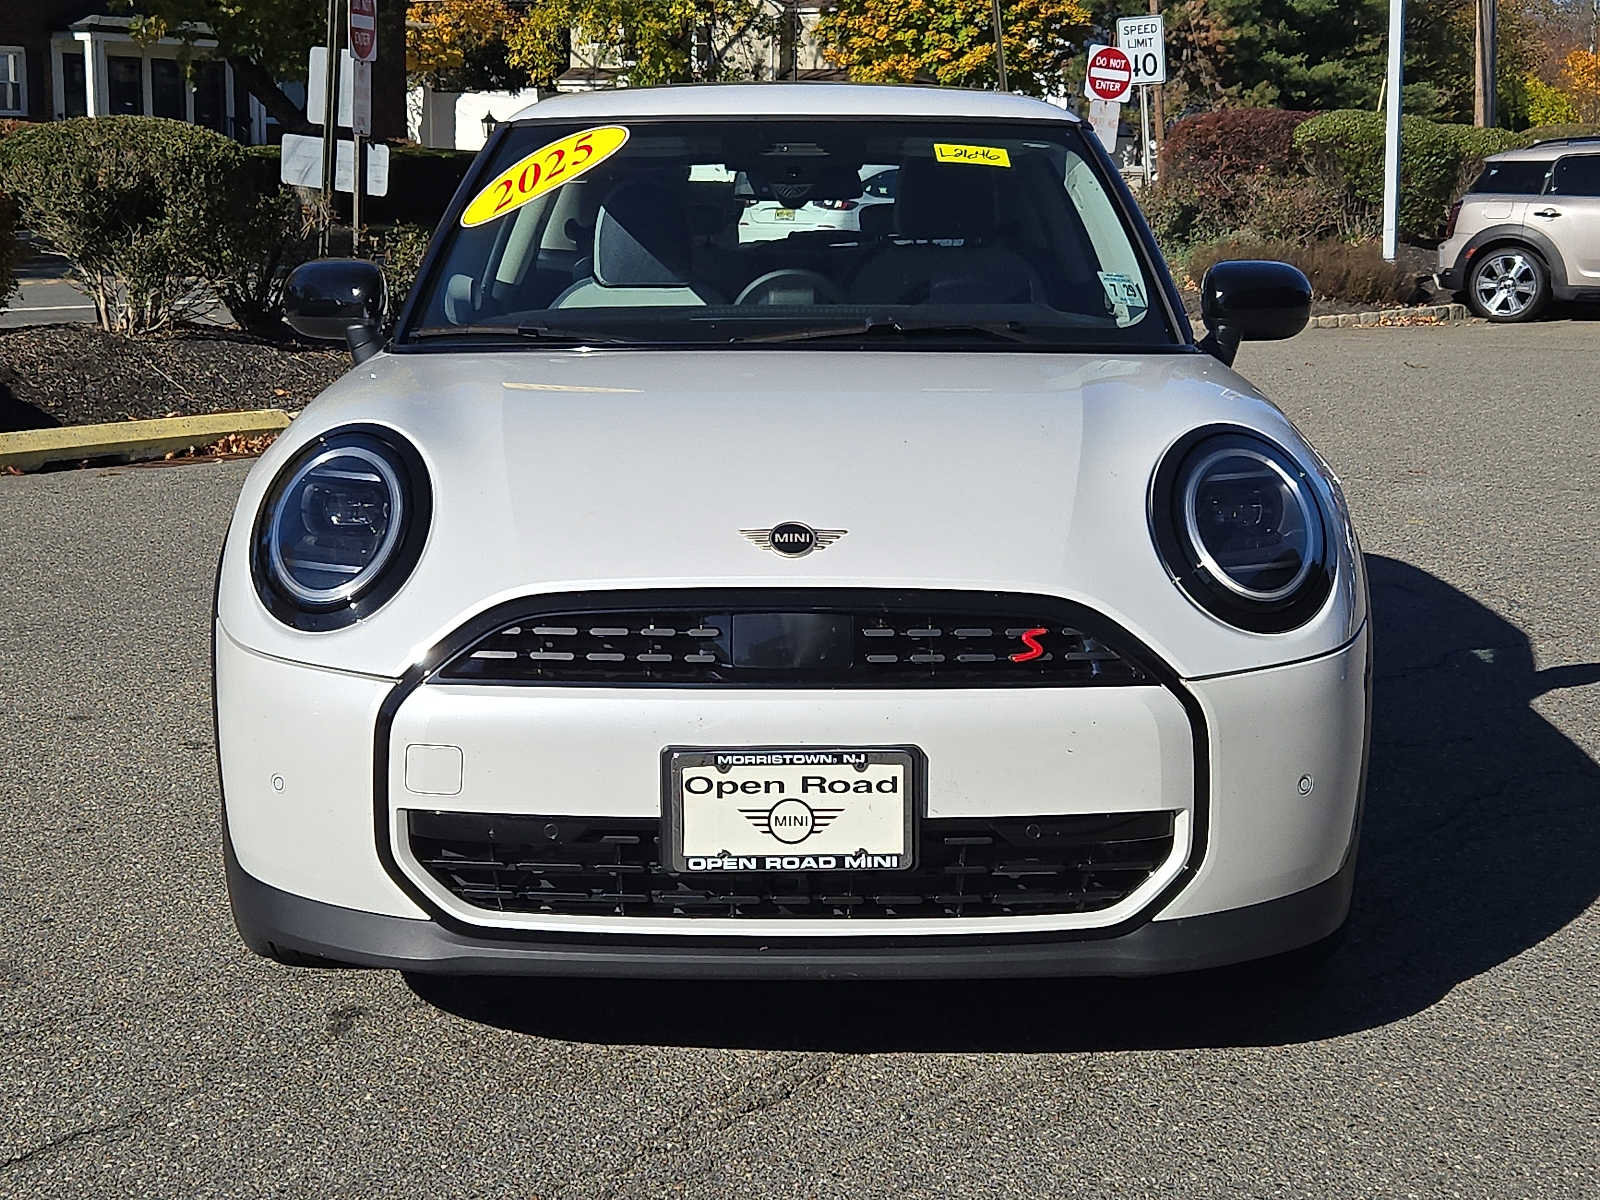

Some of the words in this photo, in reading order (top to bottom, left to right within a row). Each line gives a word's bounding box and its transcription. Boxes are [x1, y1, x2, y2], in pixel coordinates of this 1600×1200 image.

[1123, 23, 1158, 36] SPEED
[1127, 37, 1154, 49] LIMIT
[1095, 56, 1107, 67] DO
[1109, 58, 1127, 70] NOT
[1095, 80, 1121, 92] ENTER
[494, 134, 593, 214] 2025
[1109, 283, 1119, 297] 7
[1122, 283, 1137, 298] 29
[774, 533, 810, 543] MINI
[1010, 627, 1048, 662] S
[843, 753, 867, 764] NJ
[685, 776, 785, 799] Open
[801, 775, 898, 794] Road
[774, 815, 809, 827] MINI
[688, 857, 757, 870] OPEN
[765, 856, 837, 870] ROAD
[844, 855, 898, 869] MINI
